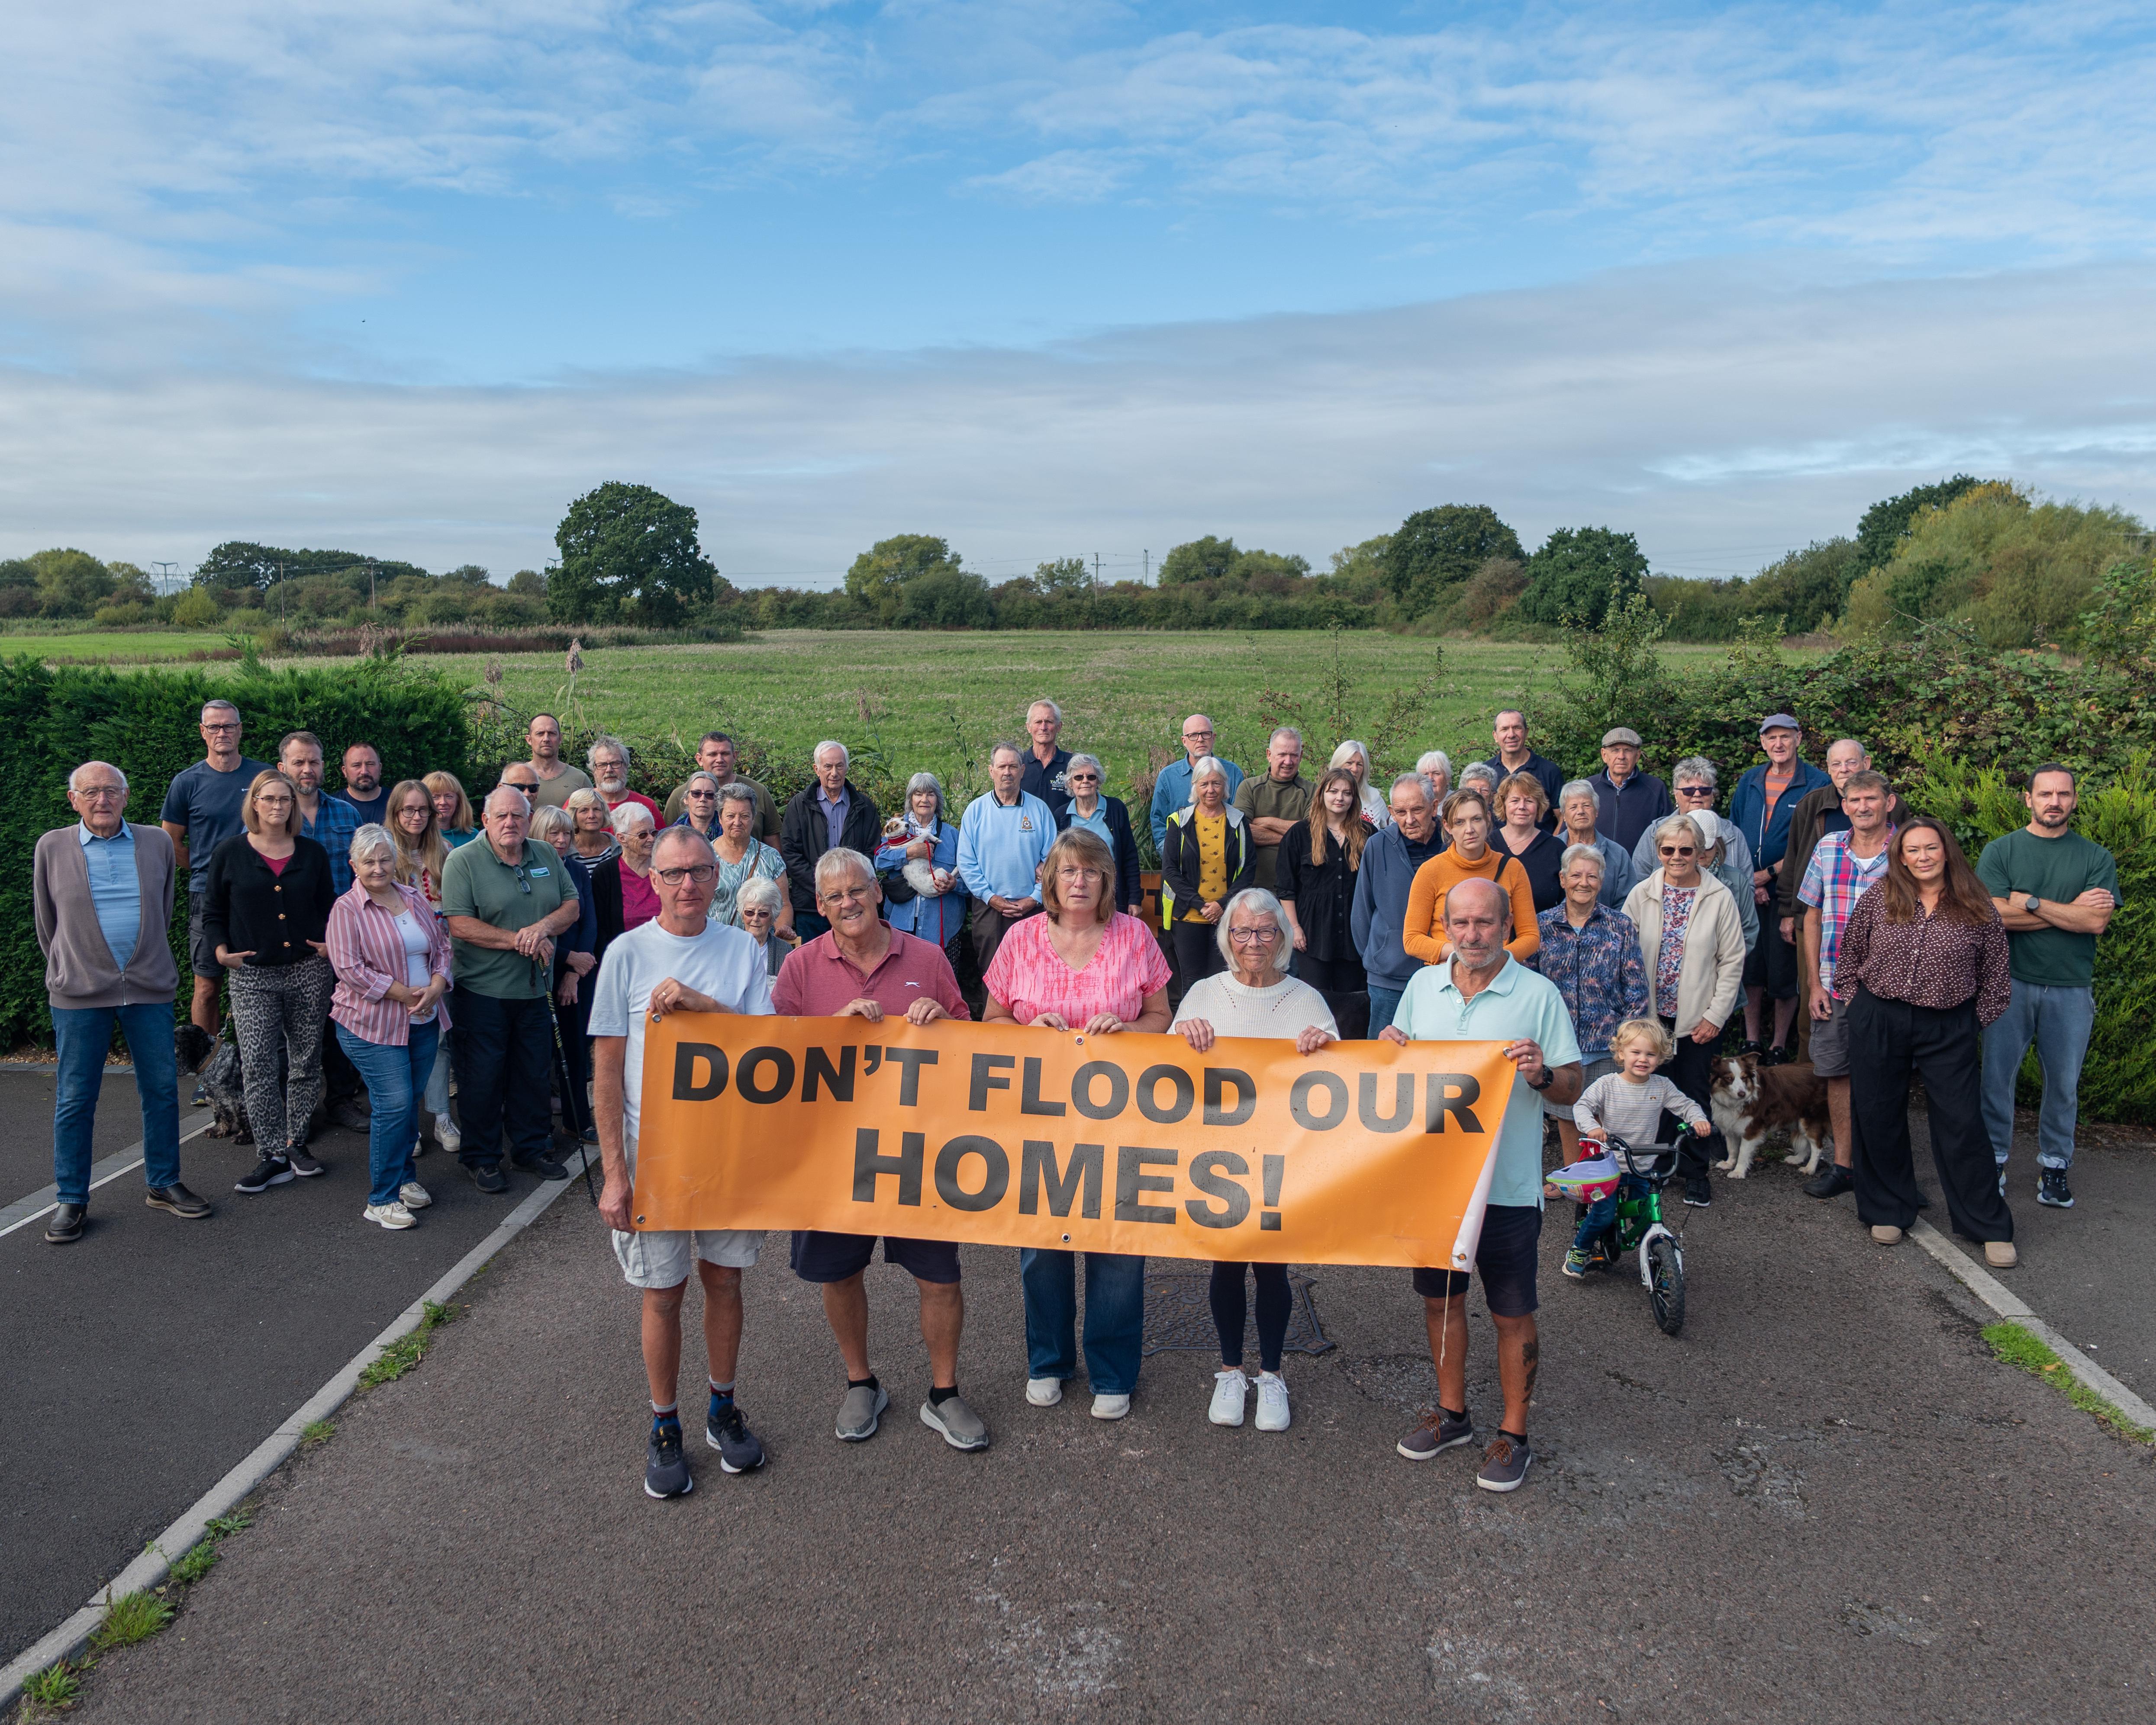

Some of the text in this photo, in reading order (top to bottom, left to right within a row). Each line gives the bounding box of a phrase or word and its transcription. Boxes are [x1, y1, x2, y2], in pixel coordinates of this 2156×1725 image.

[672, 1042, 1485, 1134] DON’T FLOOD OUR
[852, 1128, 1285, 1231] HOMES!
